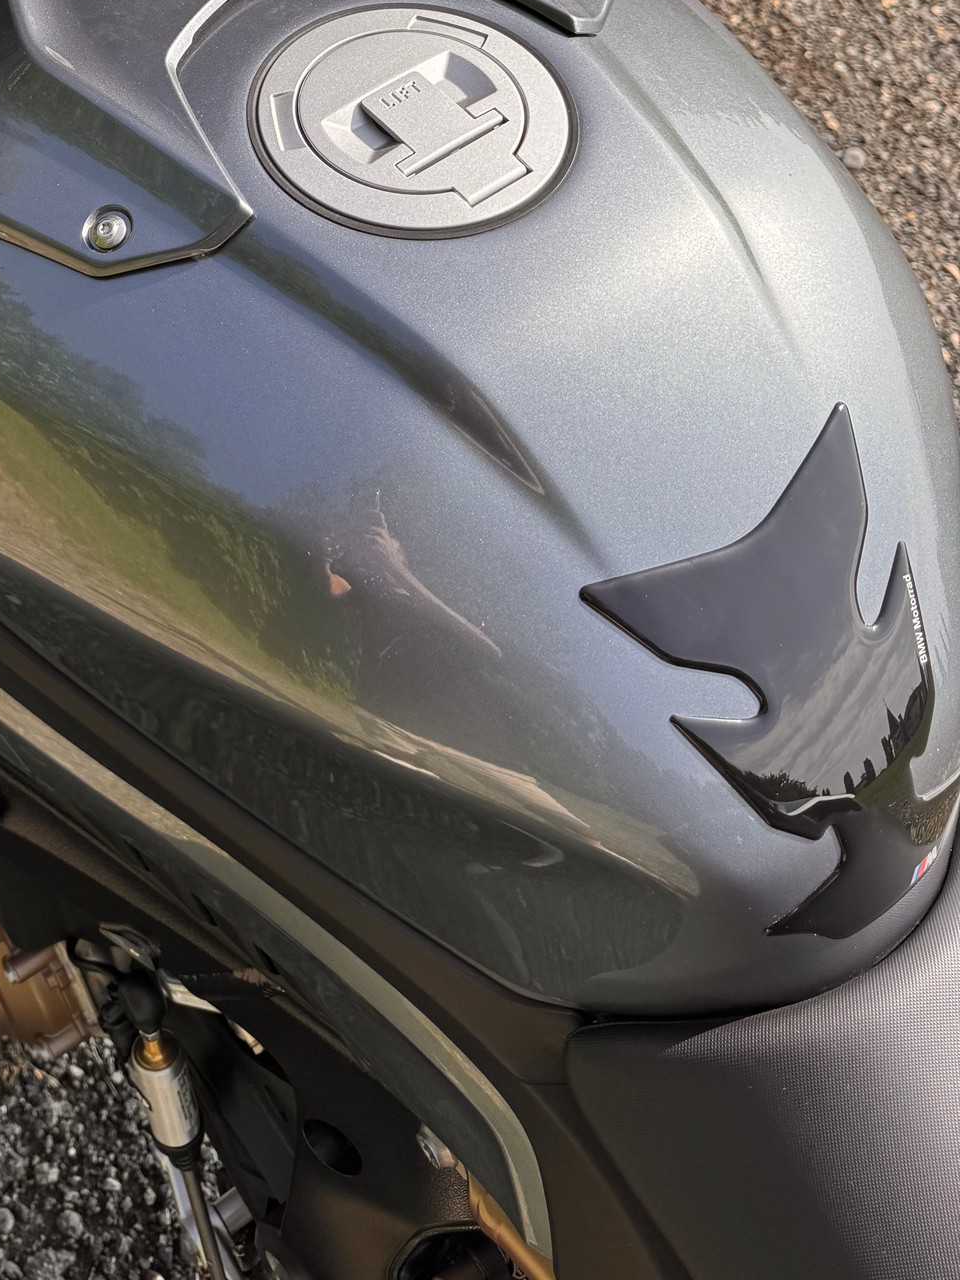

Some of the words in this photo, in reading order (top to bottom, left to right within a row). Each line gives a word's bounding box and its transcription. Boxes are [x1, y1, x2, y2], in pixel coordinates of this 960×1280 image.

[379, 80, 423, 110] LIFT
[902, 573, 921, 630] Motorrad
[915, 631, 928, 664] BMW
